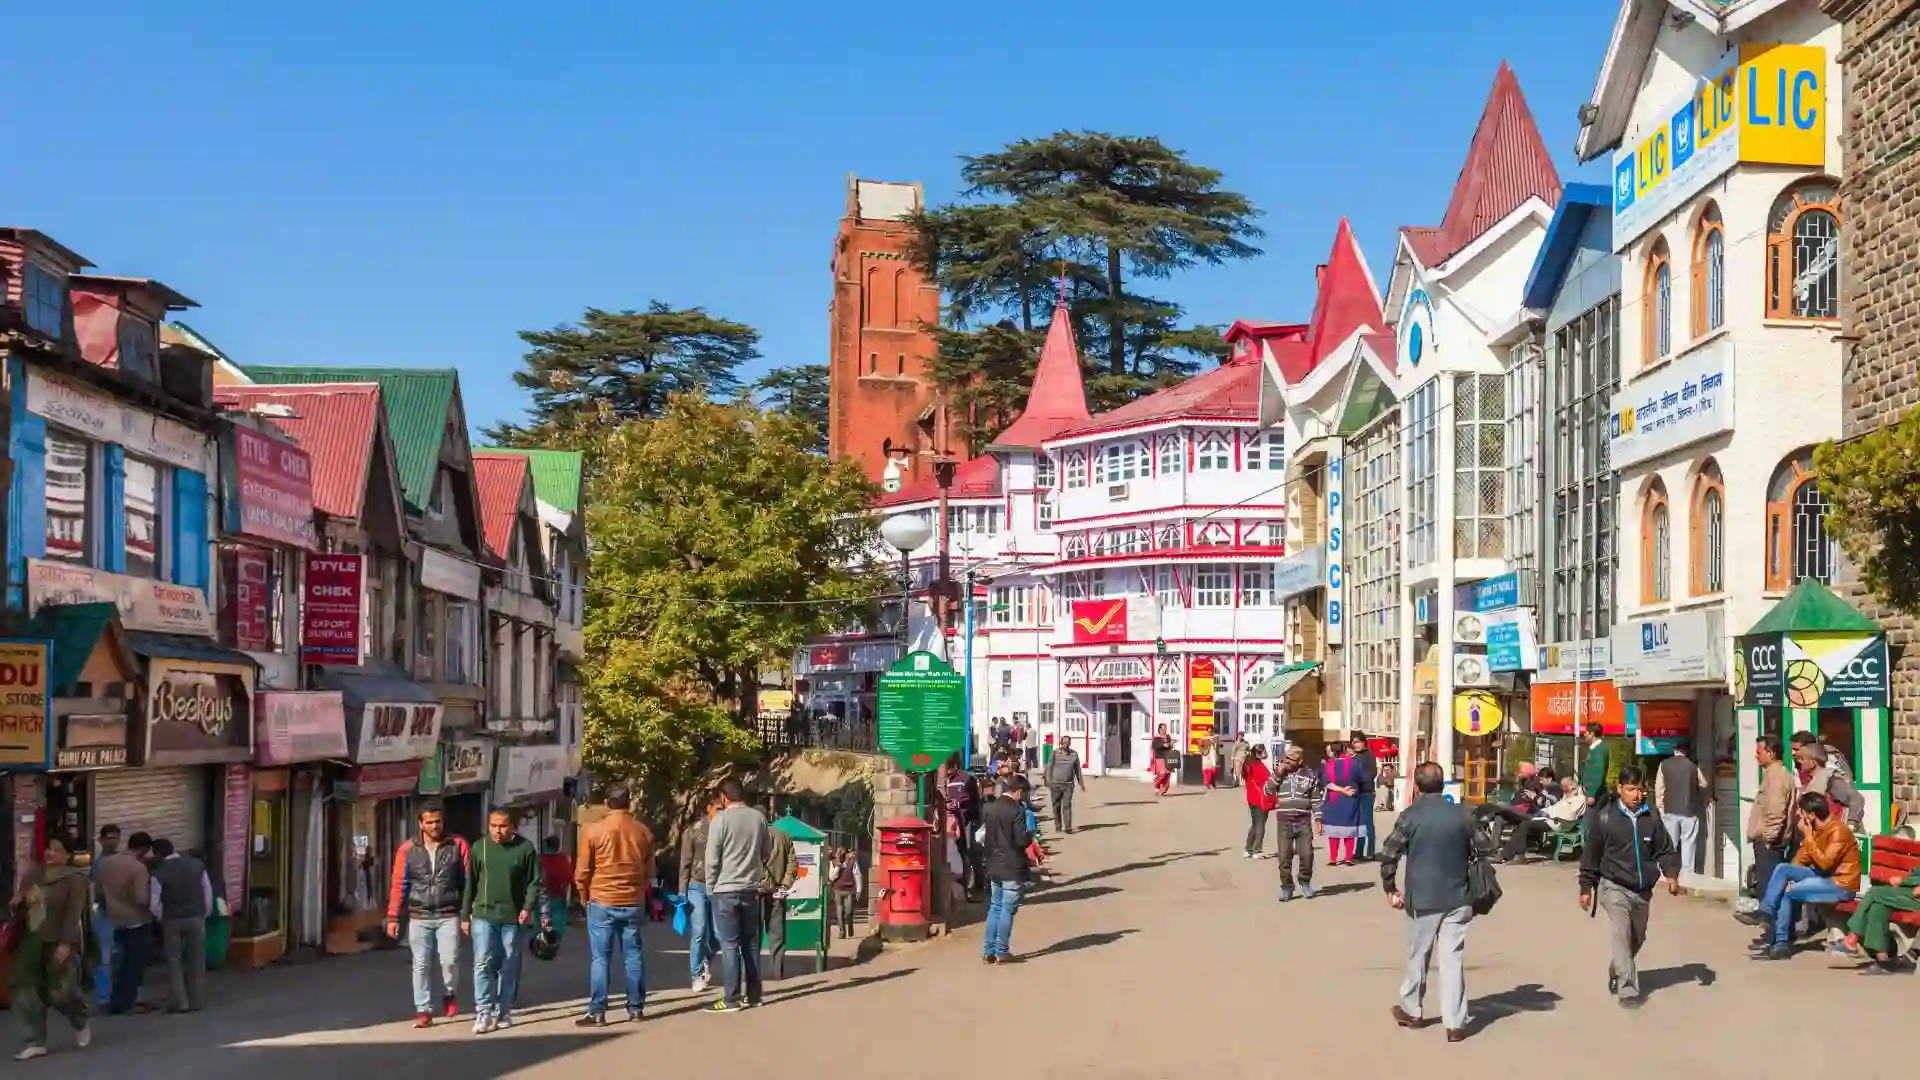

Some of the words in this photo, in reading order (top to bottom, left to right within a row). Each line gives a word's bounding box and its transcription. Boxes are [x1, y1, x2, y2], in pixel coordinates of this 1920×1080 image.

[1749, 66, 1818, 130] LIC
[1640, 132, 1665, 189] LIC
[1699, 75, 1732, 139] LIC
[241, 433, 269, 466] STYLE
[311, 560, 357, 572] STYLE
[312, 585, 353, 597] CHEK
[1653, 622, 1669, 646] LIC
[1751, 644, 1777, 671] CCC
[151, 680, 233, 736] Beekays
